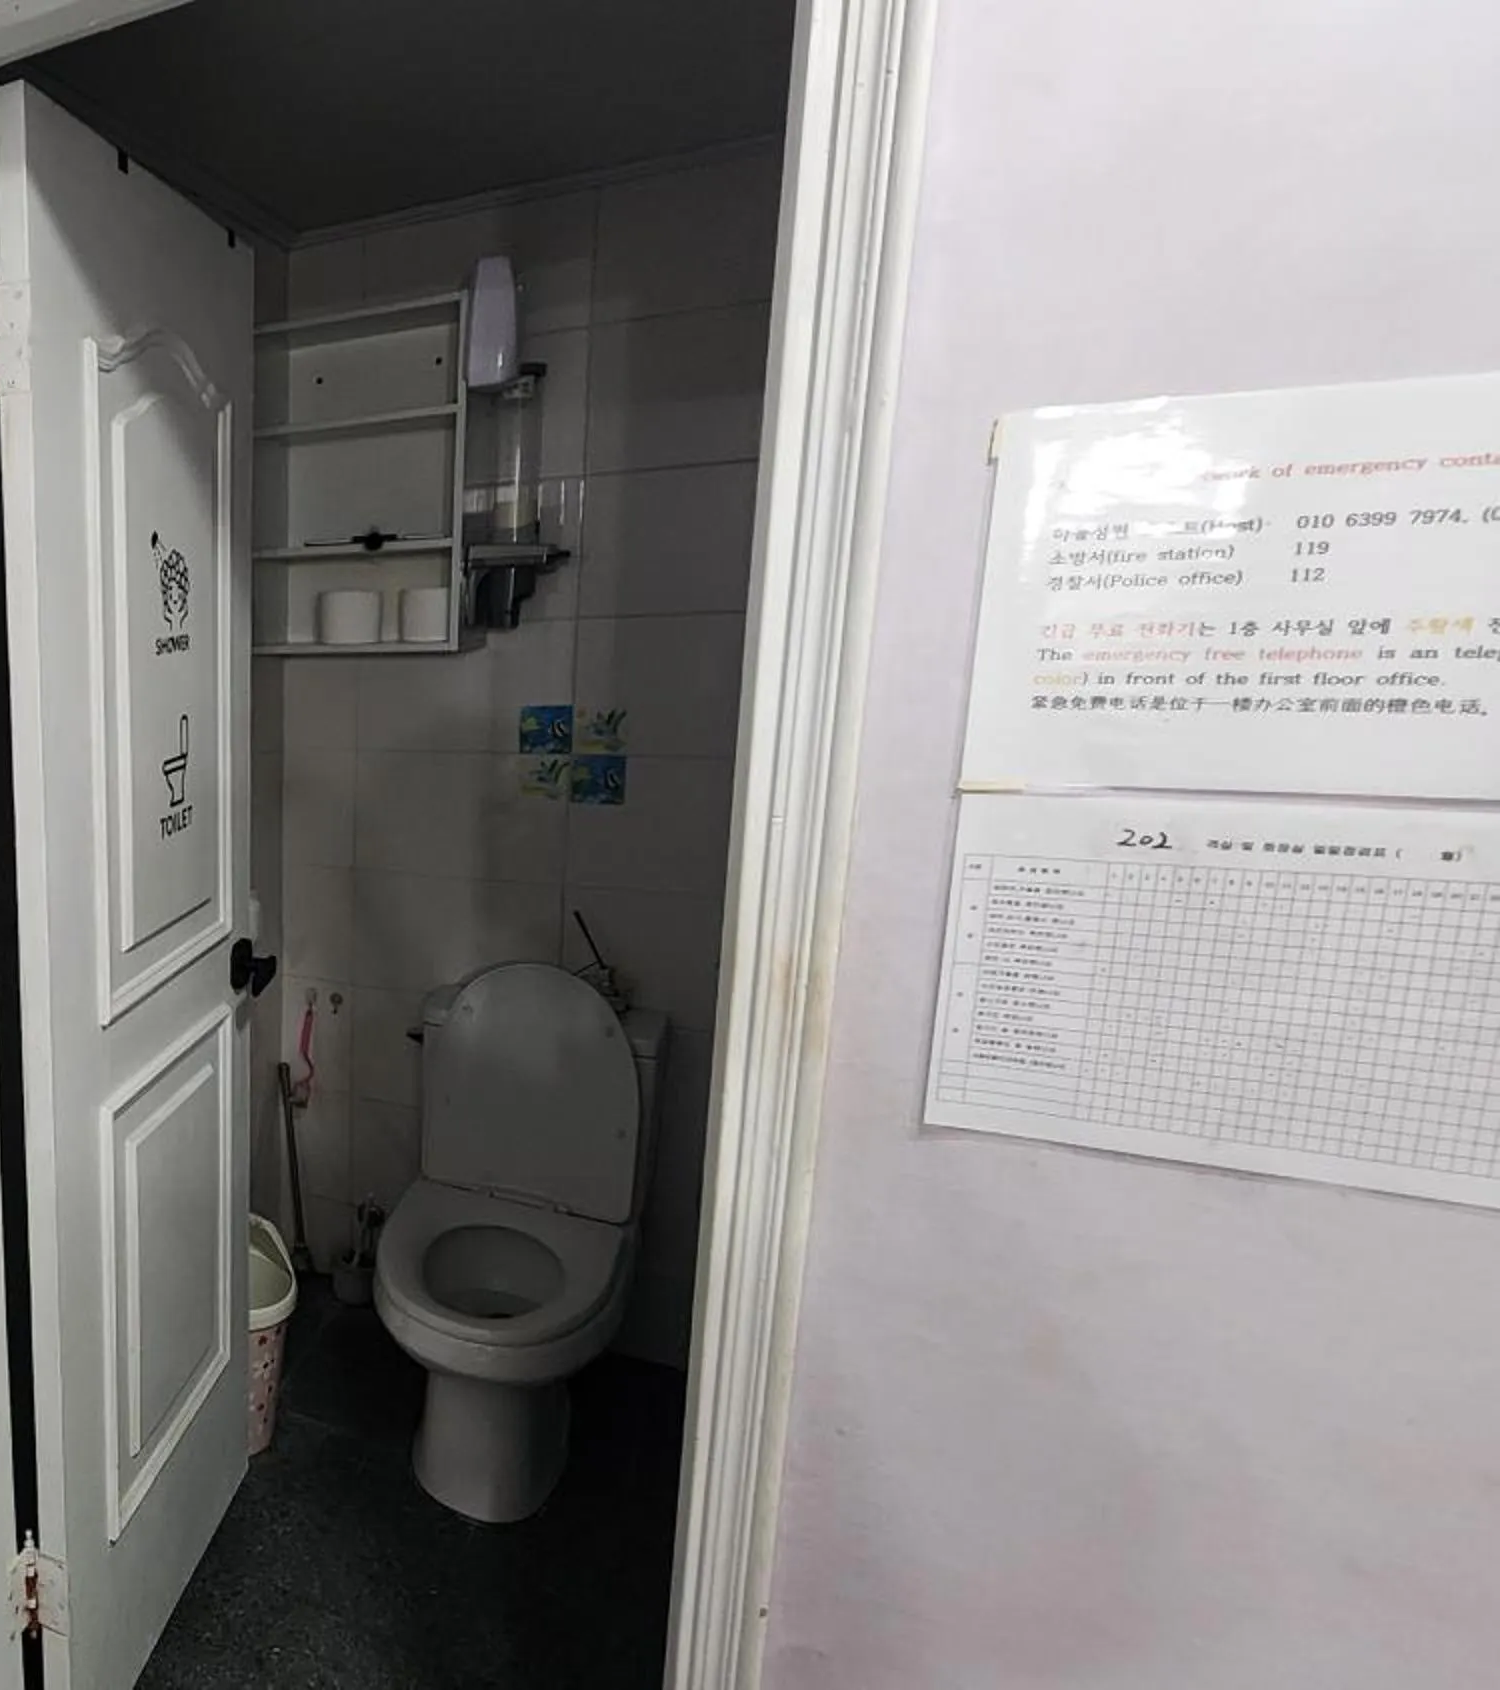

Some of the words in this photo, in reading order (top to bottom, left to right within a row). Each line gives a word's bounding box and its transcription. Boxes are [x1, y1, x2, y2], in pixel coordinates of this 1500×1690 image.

[1271, 464, 1293, 478] of
[1304, 459, 1427, 476] emergency
[1297, 513, 1335, 529] 010
[1345, 511, 1397, 527] 6399
[1156, 544, 1235, 562] station)
[1296, 541, 1330, 556] 119
[1178, 569, 1244, 587] office)
[1291, 568, 1325, 583] 112
[1228, 619, 1260, 638] 1층
[1272, 618, 1334, 637] 사무실
[1348, 617, 1391, 636] 앞에
[155, 634, 190, 656] SHOWER
[1037, 647, 1073, 662] The
[1082, 648, 1192, 663] emergency
[1203, 647, 1245, 661] free
[1258, 645, 1364, 663] telephone
[1377, 645, 1396, 659] is
[1409, 649, 1439, 659] an
[1097, 671, 1116, 685] in
[1125, 671, 1176, 686] front
[1185, 671, 1205, 686] of
[1215, 671, 1250, 686] the
[1258, 671, 1303, 686] first
[1312, 671, 1365, 686] floor
[1375, 671, 1447, 687] office.
[159, 805, 193, 840] TOILET
[1117, 828, 1173, 849] 202
